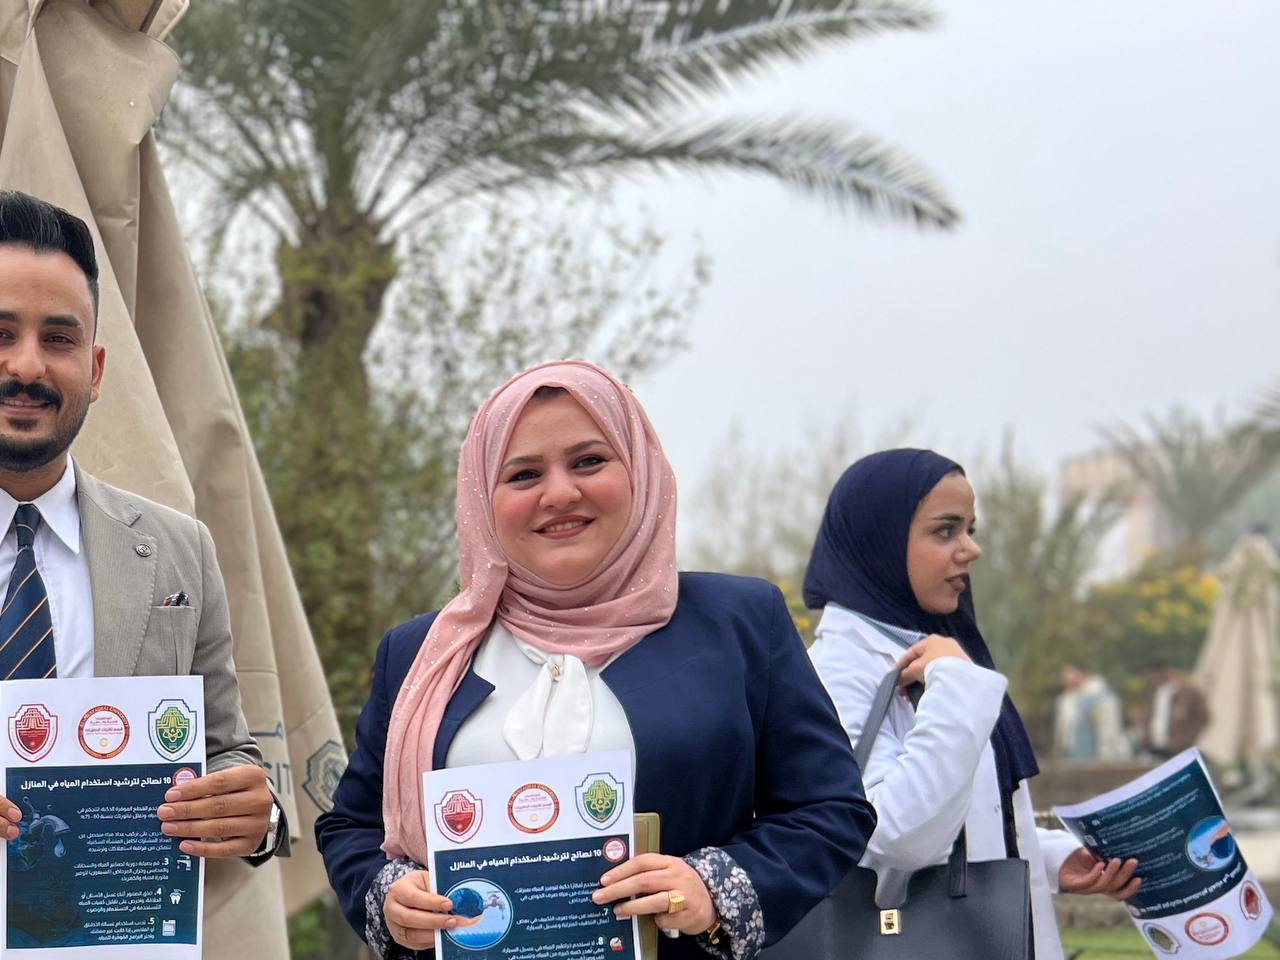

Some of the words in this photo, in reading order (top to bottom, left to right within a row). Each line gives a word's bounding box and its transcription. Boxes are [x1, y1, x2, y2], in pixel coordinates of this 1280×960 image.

[21, 781, 46, 790] المنازل
[48, 781, 59, 791] في
[60, 780, 80, 788] المياه
[81, 778, 112, 789] استخدام
[113, 778, 140, 787] لترشيد
[141, 777, 162, 787] نصائح
[542, 851, 569, 862] لترشيد
[570, 850, 592, 861] نصائح
[593, 849, 602, 857] 10
[450, 860, 475, 871] المنازل
[476, 860, 488, 870] في
[488, 857, 509, 866] المياه
[510, 855, 541, 867] استخدام
